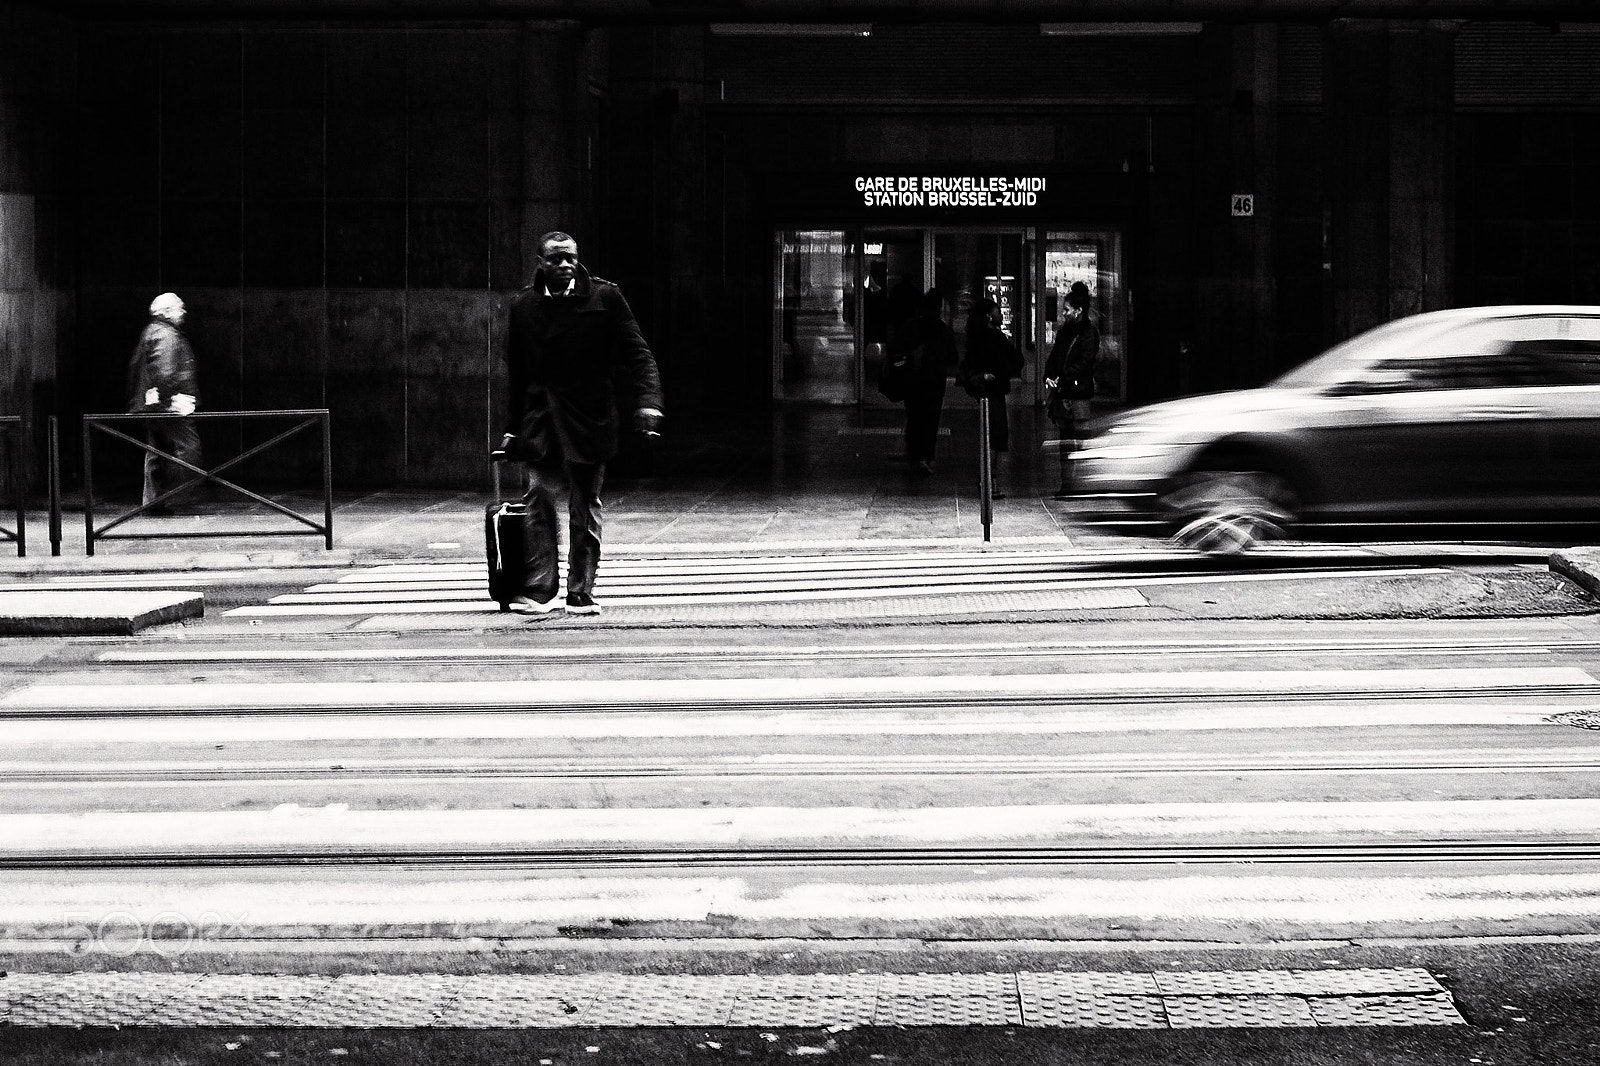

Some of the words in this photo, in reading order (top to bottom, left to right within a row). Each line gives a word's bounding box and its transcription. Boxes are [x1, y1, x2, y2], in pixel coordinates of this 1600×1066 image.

[855, 176, 895, 191] GARE
[897, 176, 919, 191] DE
[921, 176, 1046, 191] BRUXELLES-MIDI
[863, 191, 925, 207] STATION
[928, 191, 1037, 207] BRUSSEL-ZUID
[1233, 197, 1252, 213] 46
